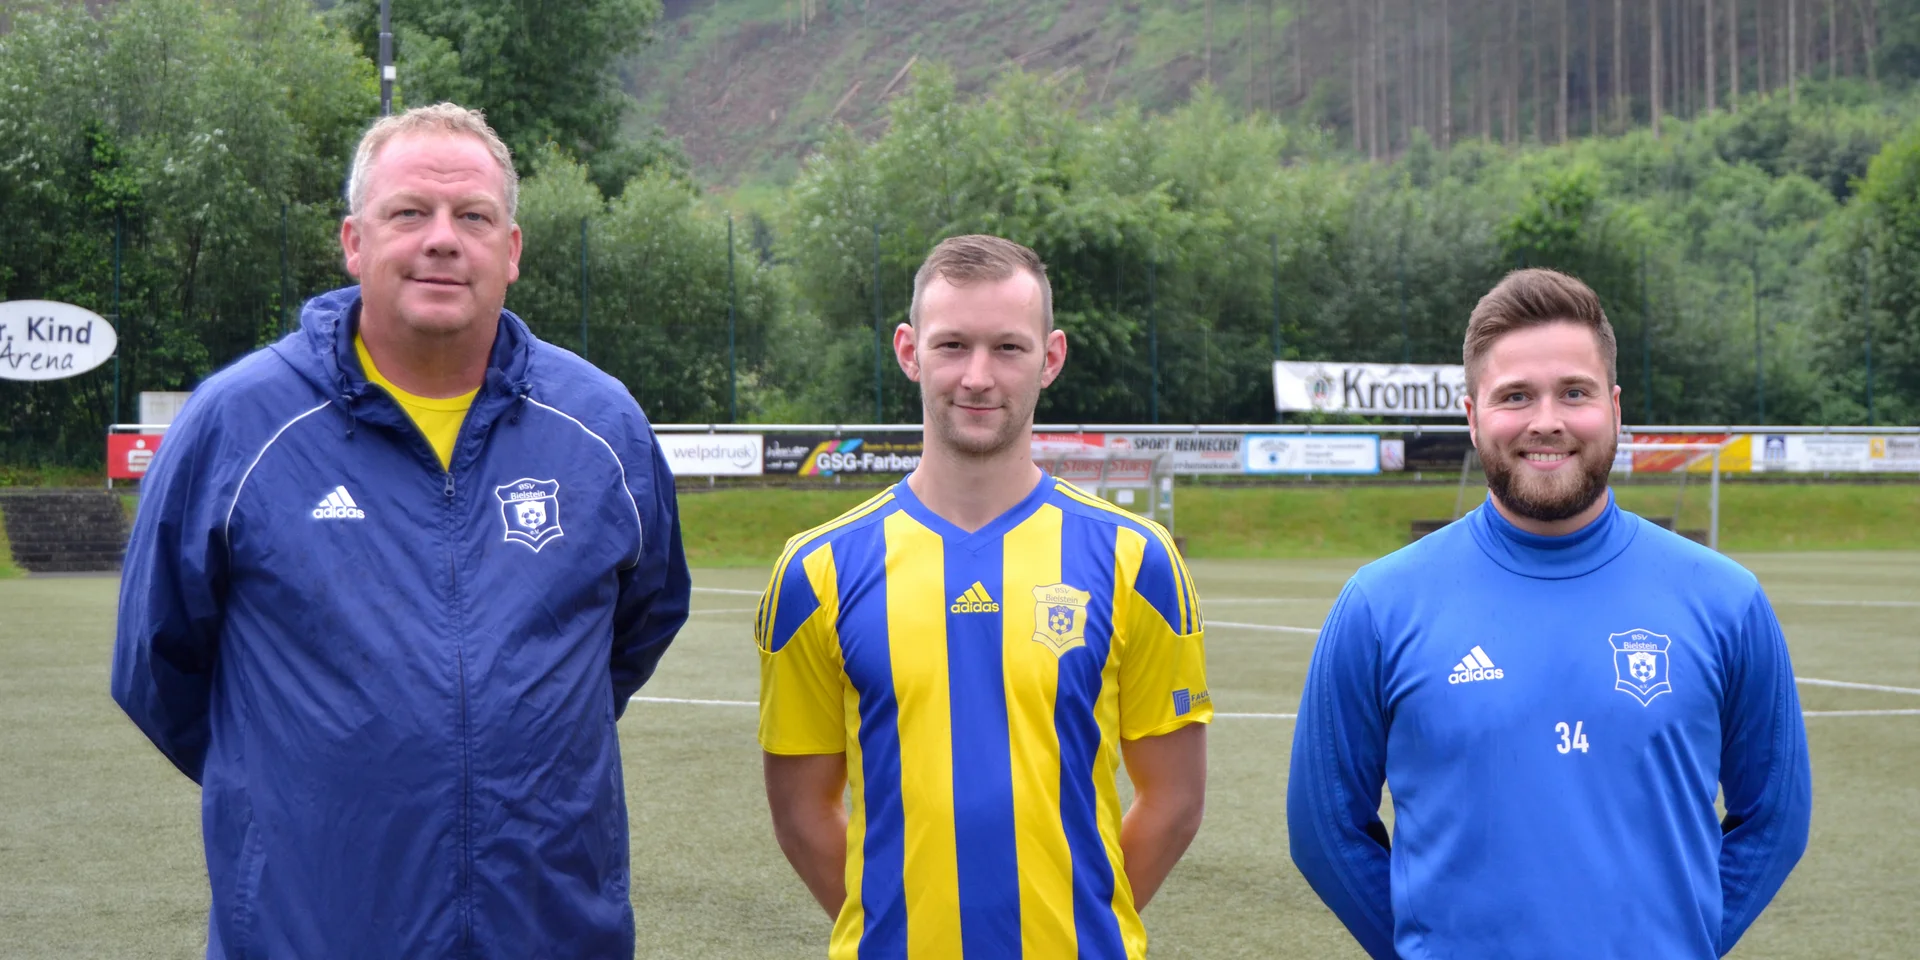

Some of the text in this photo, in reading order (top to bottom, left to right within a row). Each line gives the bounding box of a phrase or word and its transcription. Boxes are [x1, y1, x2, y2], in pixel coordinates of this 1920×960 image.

[28, 316, 92, 344] Kind
[0, 341, 73, 370] Arena
[1134, 438, 1171, 450] SPORT
[1175, 438, 1240, 452] HENNECKEN
[673, 444, 752, 462] welpdruck
[510, 490, 545, 500] Bielstein
[312, 505, 365, 519] adidas
[1045, 594, 1079, 604] Bielstein
[950, 601, 1000, 613] adidas
[1623, 641, 1658, 650] Bielstein
[1448, 667, 1504, 684] adidas
[1555, 721, 1589, 754] 34
